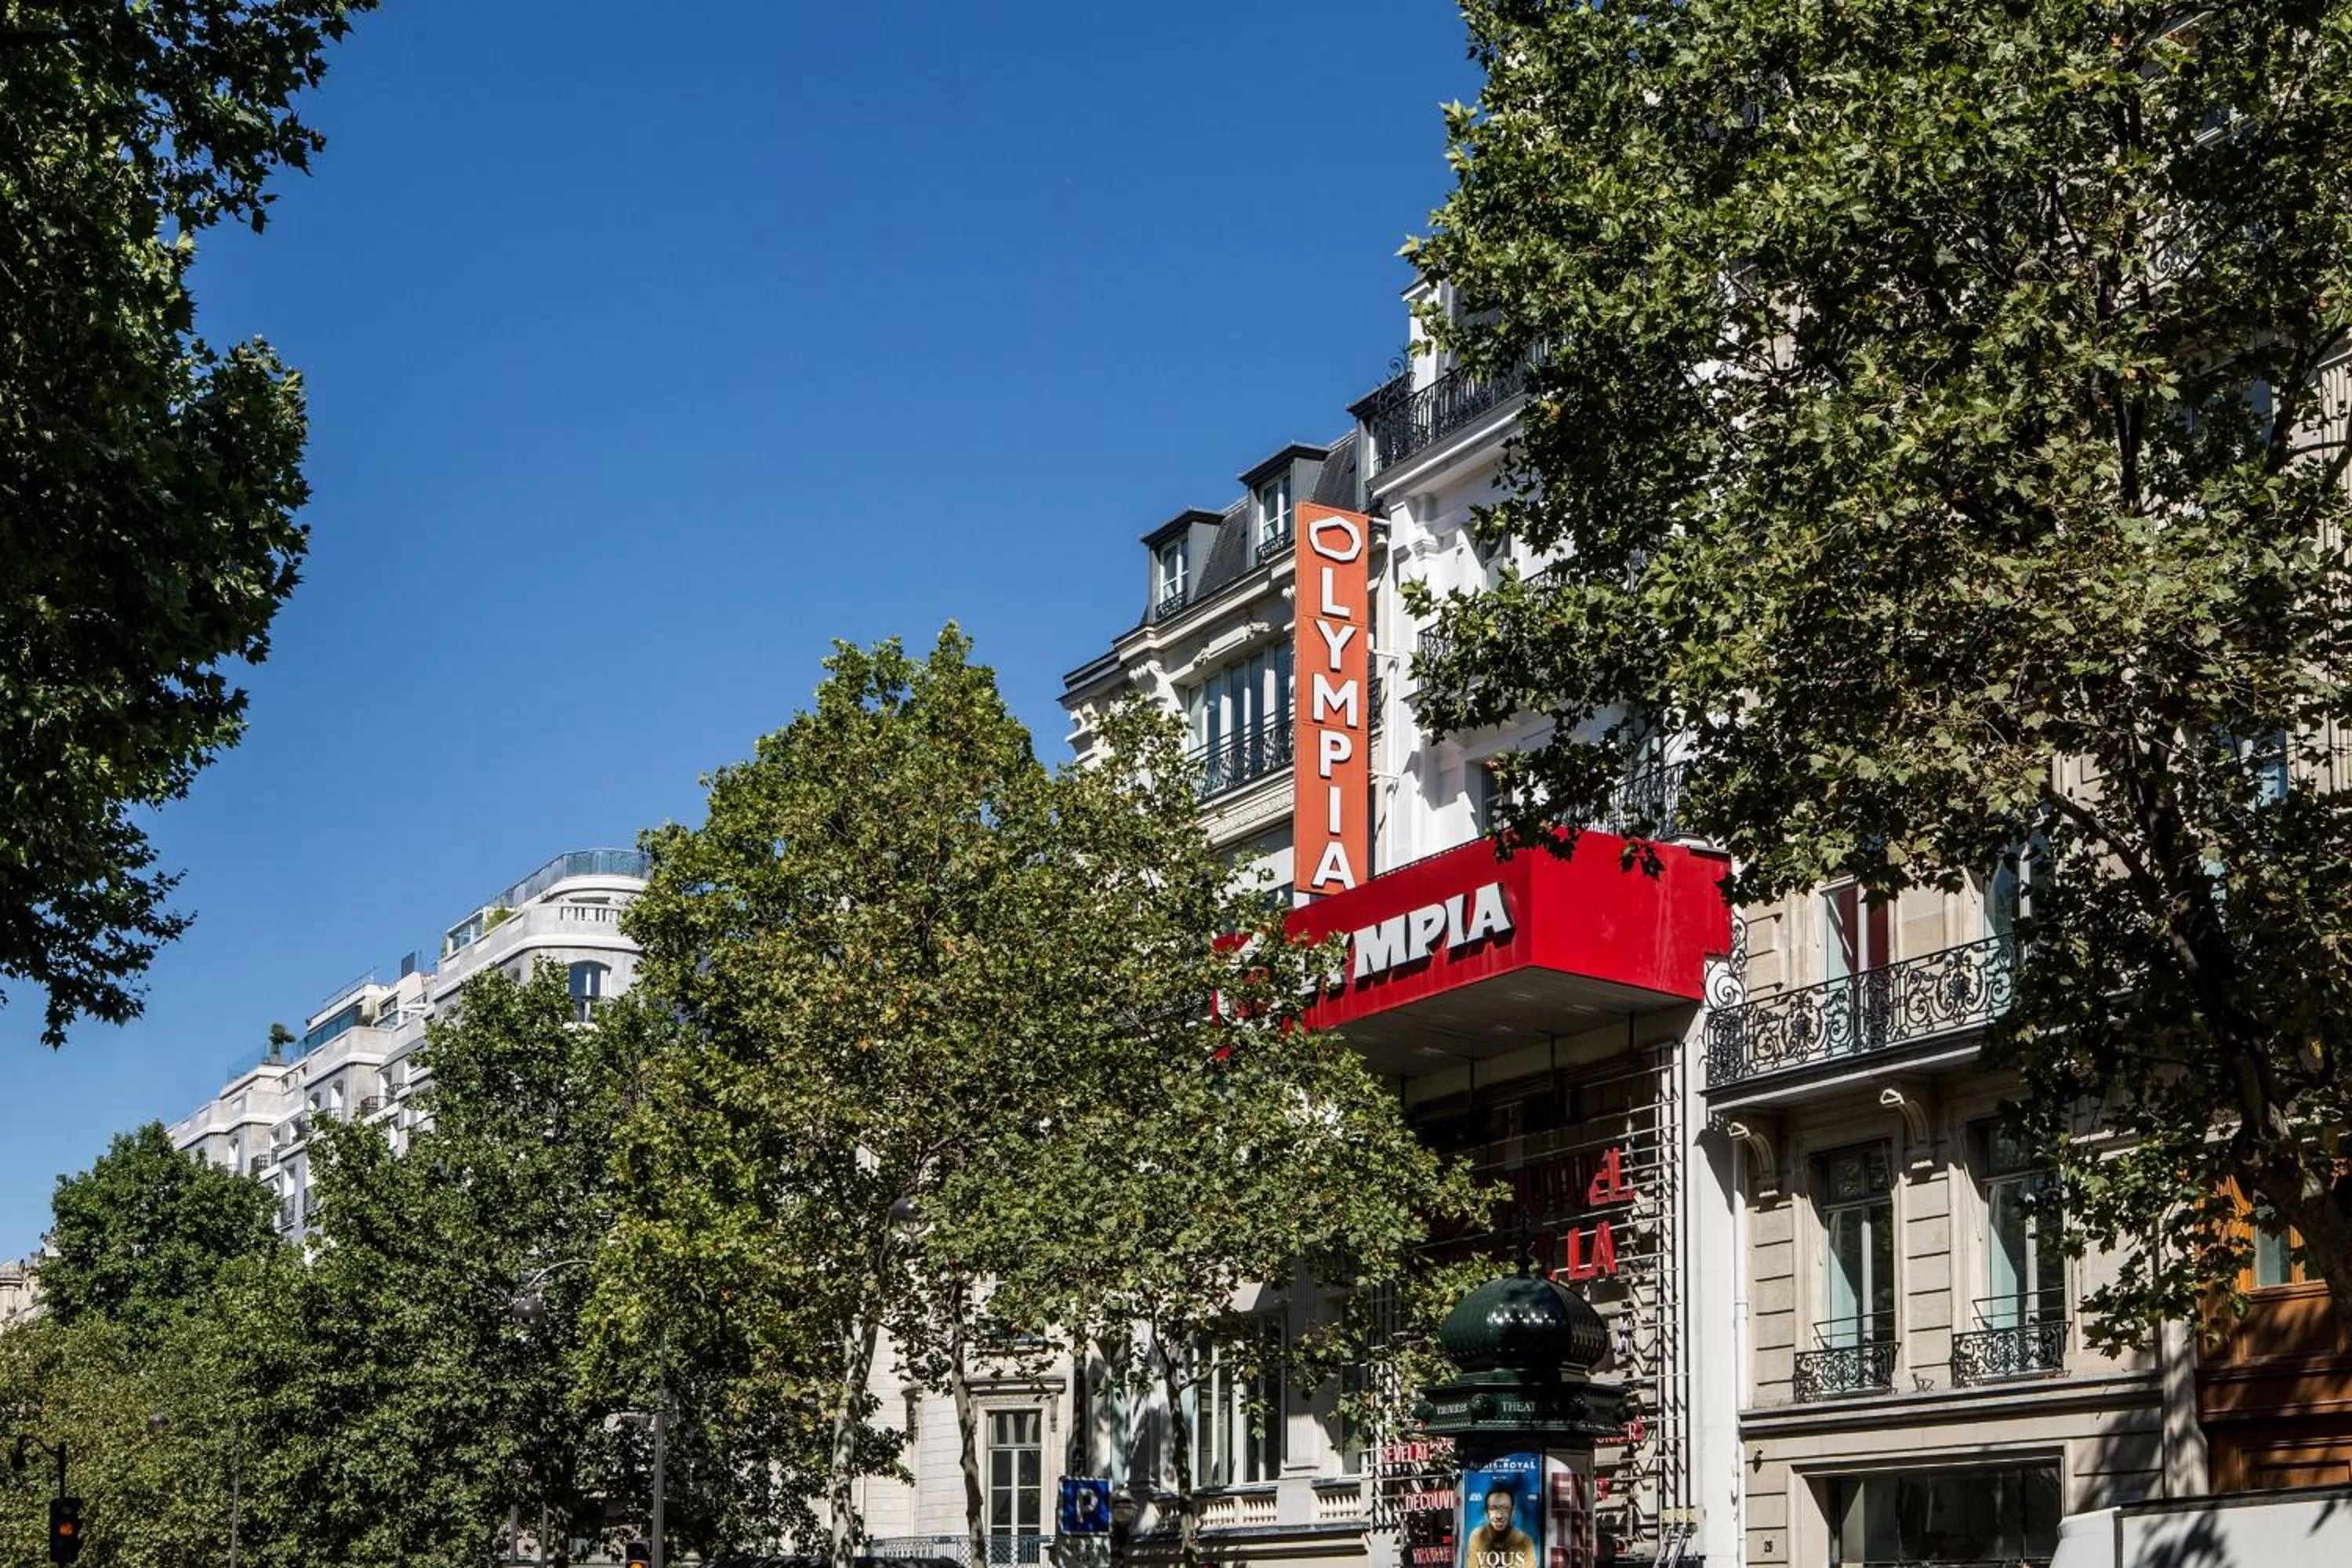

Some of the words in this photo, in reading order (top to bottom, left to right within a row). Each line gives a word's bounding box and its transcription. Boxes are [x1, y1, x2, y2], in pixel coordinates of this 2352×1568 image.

[1308, 515, 1363, 891] OLYMPIA
[1568, 1221, 1618, 1280] LA
[1076, 1487, 1098, 1523] P
[1476, 1550, 1525, 1566] VOUS
